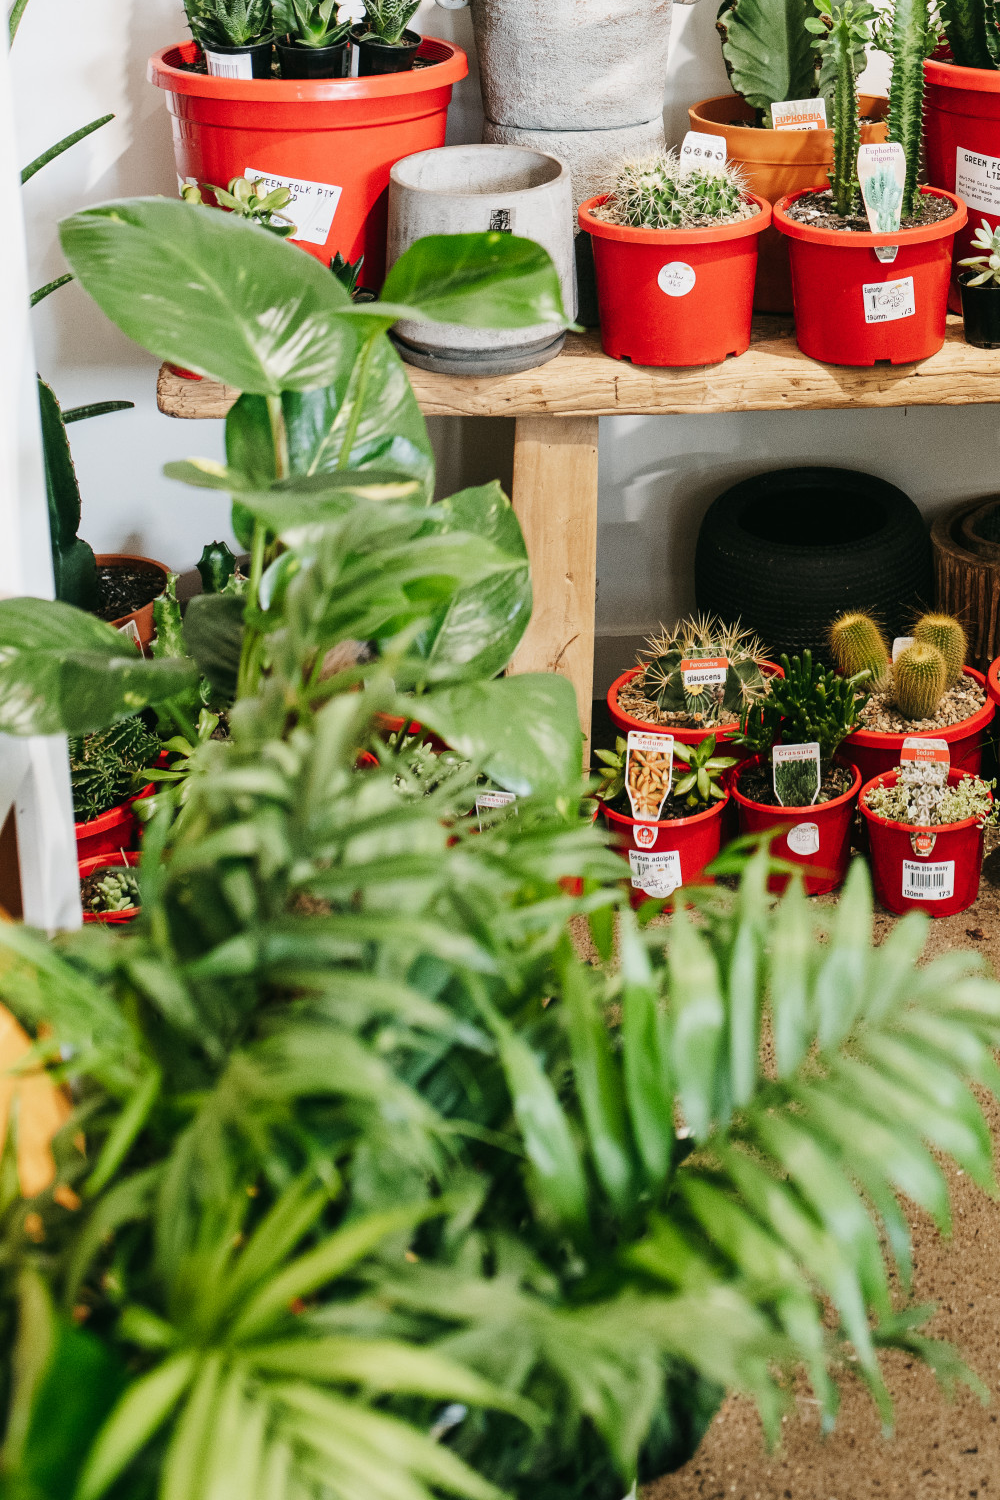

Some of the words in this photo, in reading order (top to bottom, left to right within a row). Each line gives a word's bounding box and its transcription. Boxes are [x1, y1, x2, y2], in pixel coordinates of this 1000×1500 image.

[775, 112, 821, 123] EUPHORBIA
[865, 146, 900, 155] Euphorbia
[871, 156, 895, 164] trigona
[964, 154, 988, 168] GREEN
[254, 175, 282, 188] GEEN
[288, 183, 312, 194] FOLK
[317, 188, 335, 198] PTY
[686, 674, 721, 684] glauscens
[638, 738, 664, 747] Sedum
[778, 749, 813, 757] Crassula
[630, 853, 650, 862] Sedum
[904, 863, 921, 871] Sedum
[904, 889, 924, 898] 130mm
